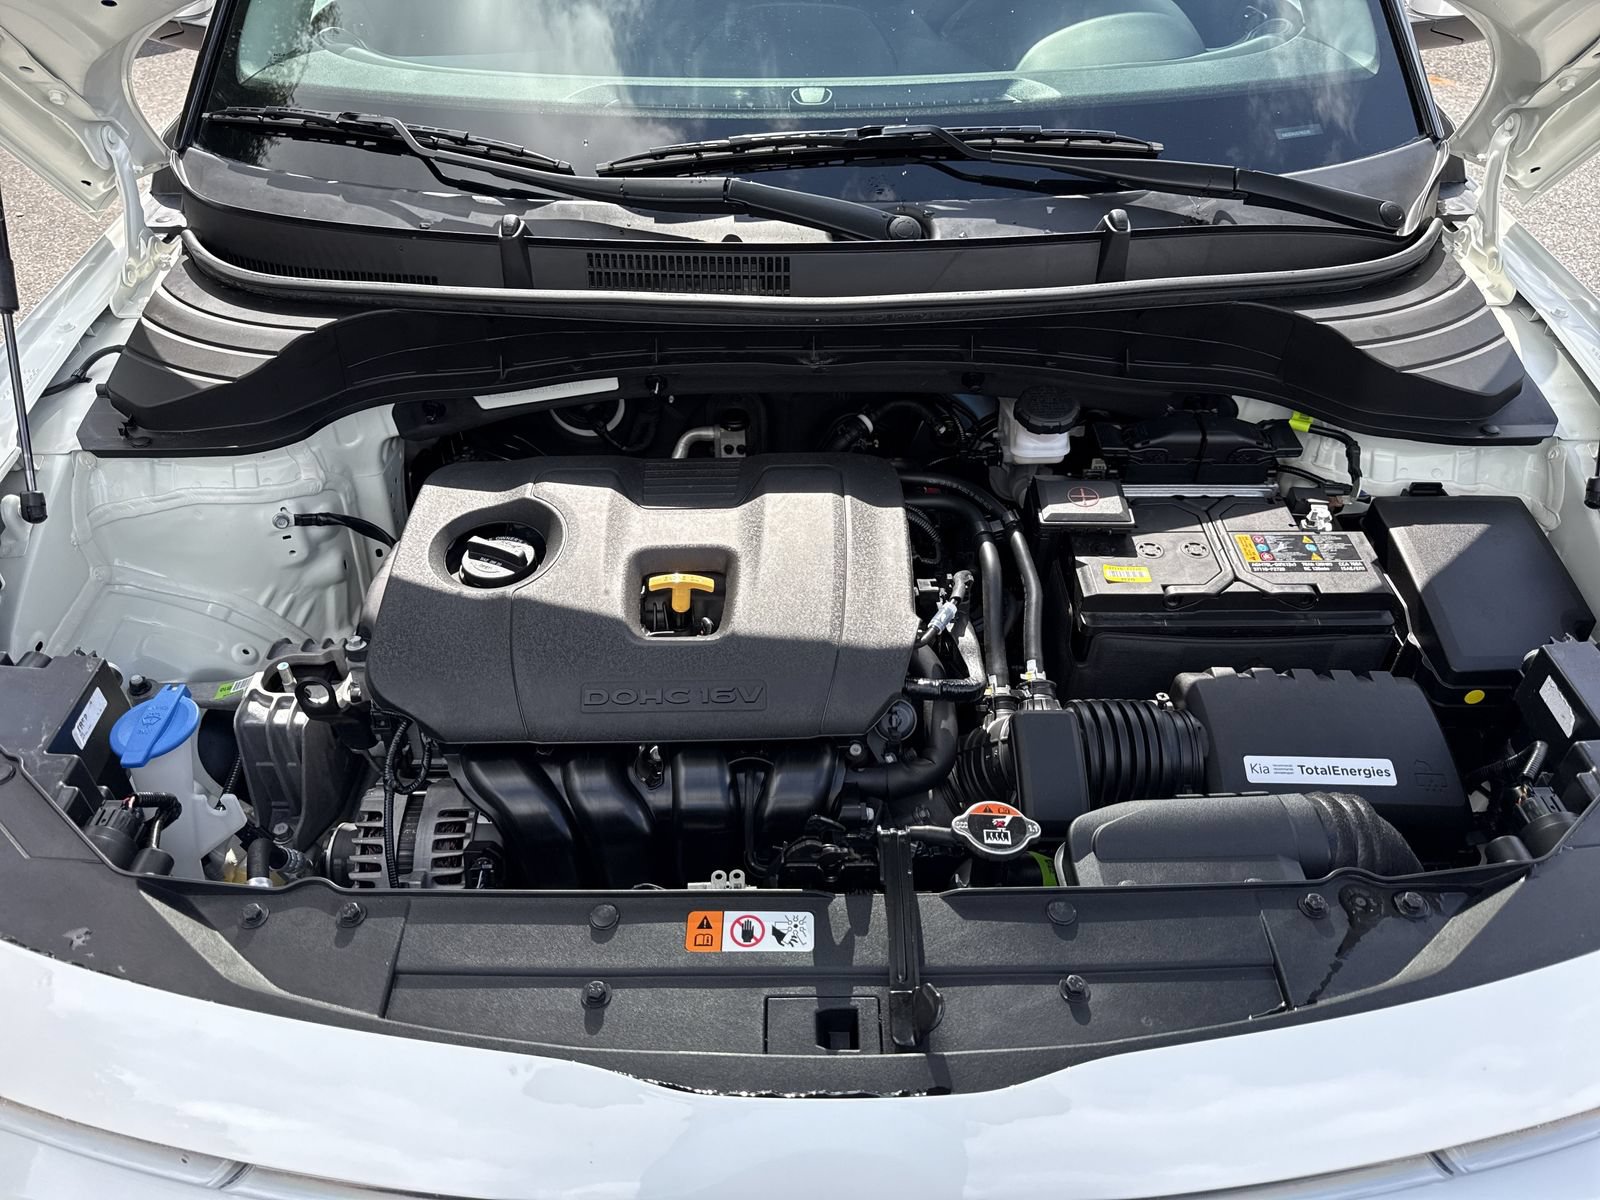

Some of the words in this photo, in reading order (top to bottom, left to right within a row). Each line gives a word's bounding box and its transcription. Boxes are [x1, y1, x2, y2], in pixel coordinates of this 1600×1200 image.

[583, 687, 691, 706] DOHC
[700, 687, 764, 705] 16V
[1250, 763, 1270, 775] Kia
[1297, 764, 1391, 779] TotalEnergies
